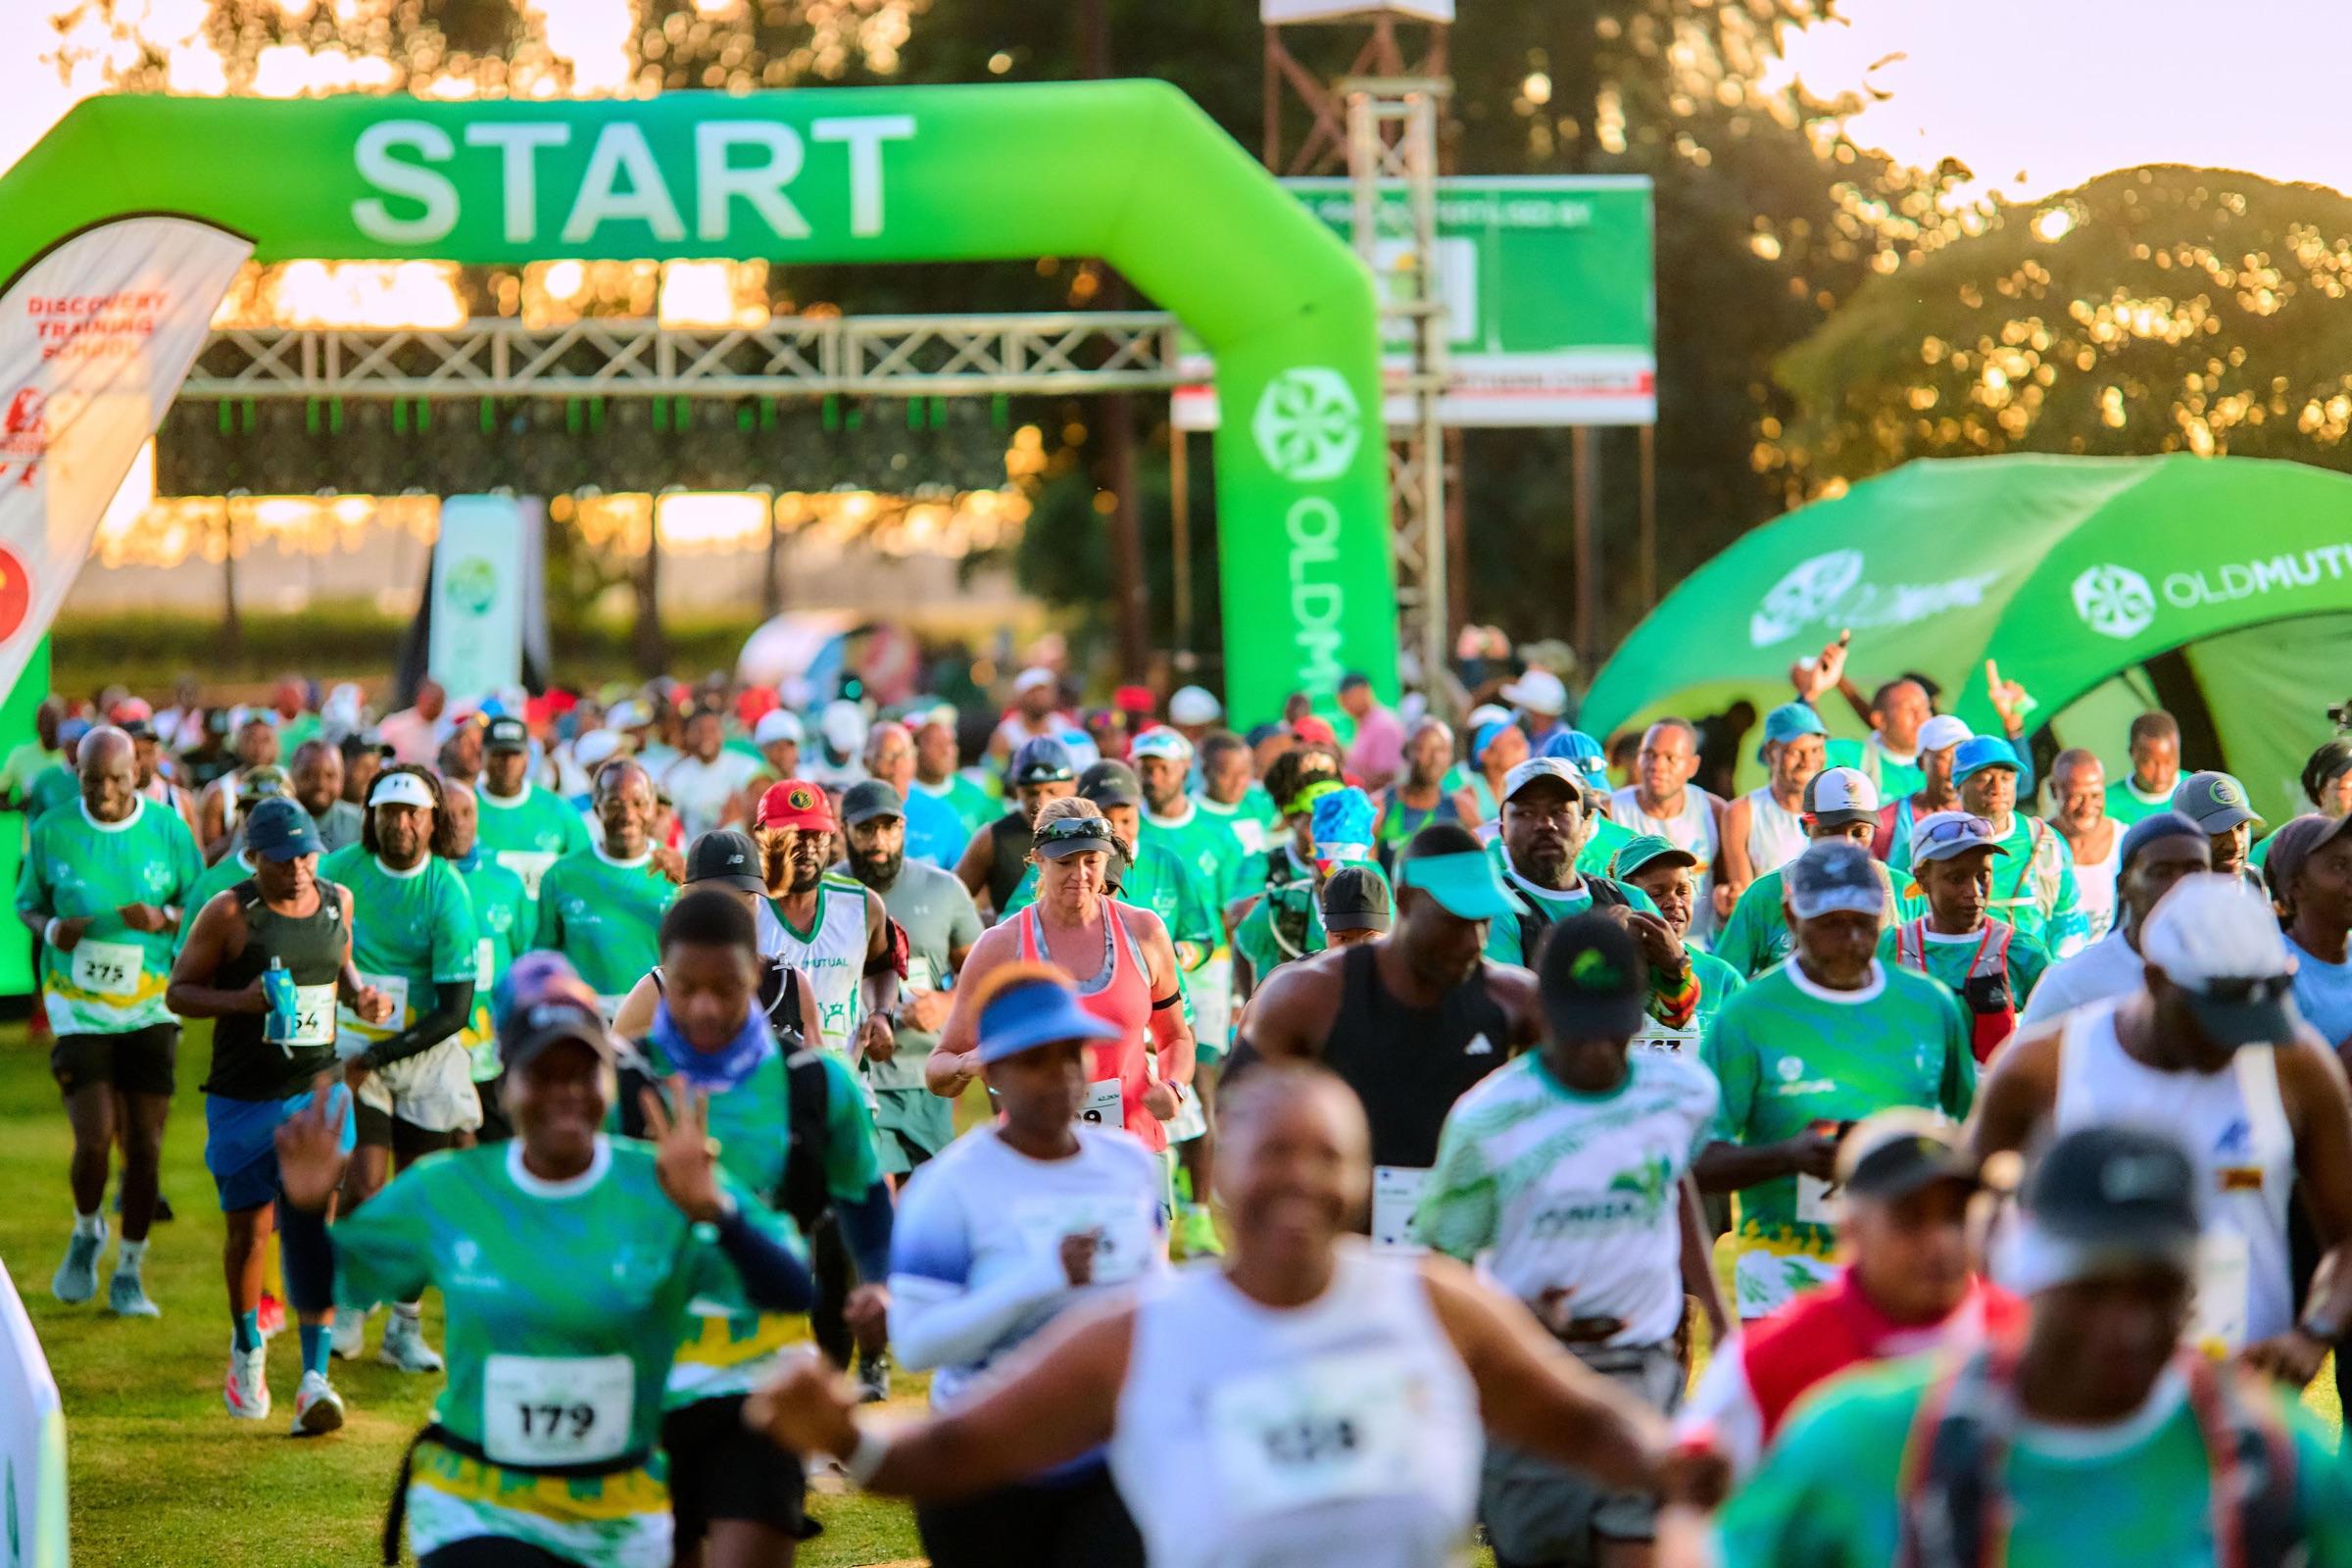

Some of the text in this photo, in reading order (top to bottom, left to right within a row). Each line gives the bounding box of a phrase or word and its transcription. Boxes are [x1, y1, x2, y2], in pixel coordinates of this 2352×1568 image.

[351, 116, 916, 245] START
[27, 293, 169, 316] DISCOVERY
[37, 318, 154, 338] TRAINING
[85, 959, 123, 983] 275
[520, 1402, 596, 1442] 179
